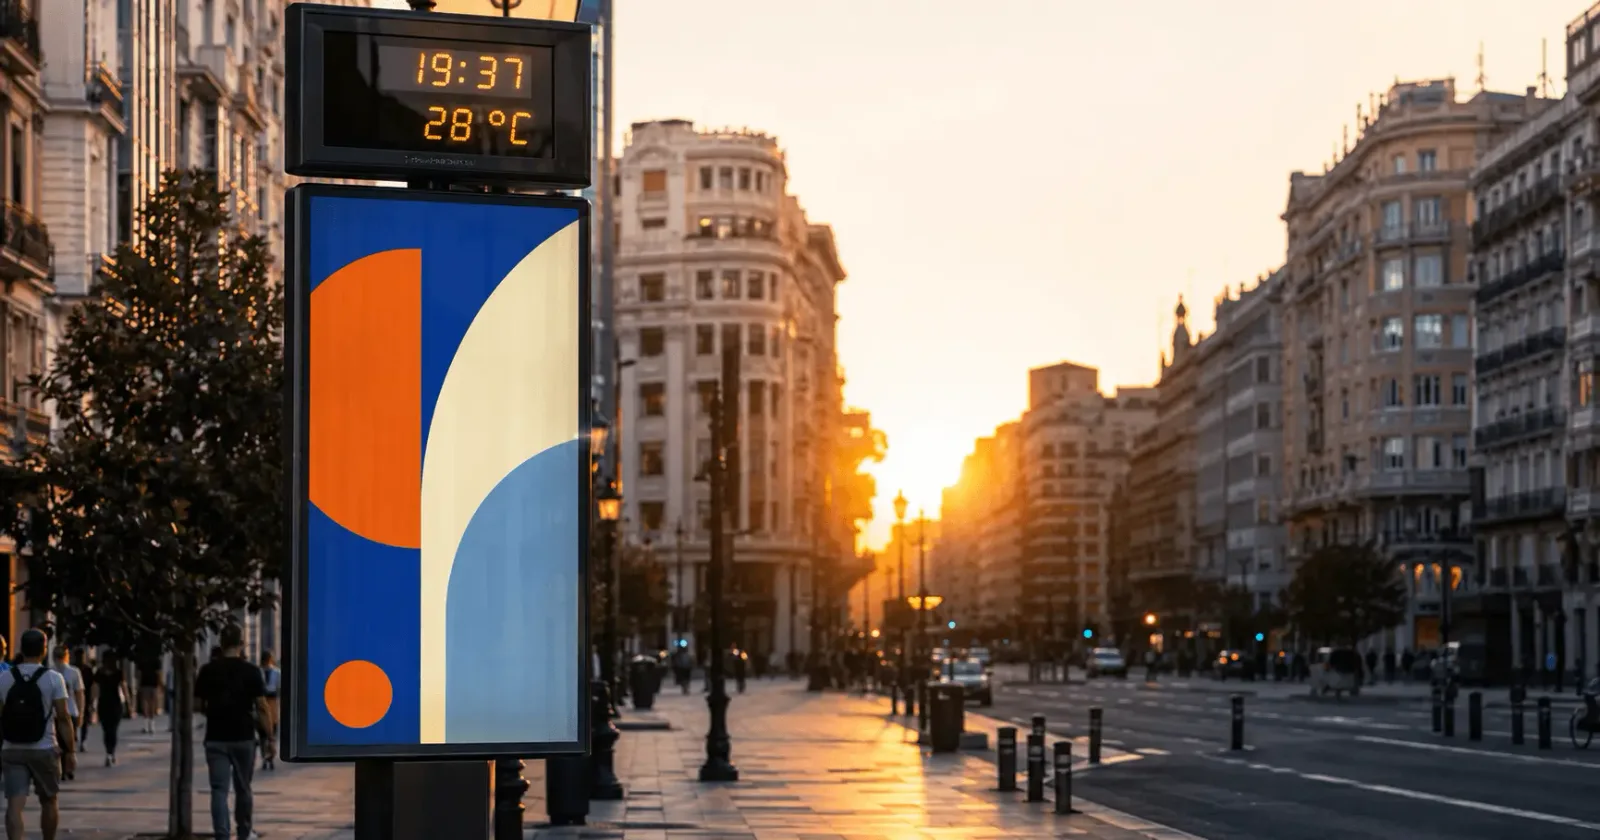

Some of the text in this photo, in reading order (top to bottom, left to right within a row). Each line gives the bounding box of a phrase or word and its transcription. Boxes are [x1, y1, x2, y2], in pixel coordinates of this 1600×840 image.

[416, 52, 524, 89] 19:37
[424, 107, 532, 145] 28 °C
